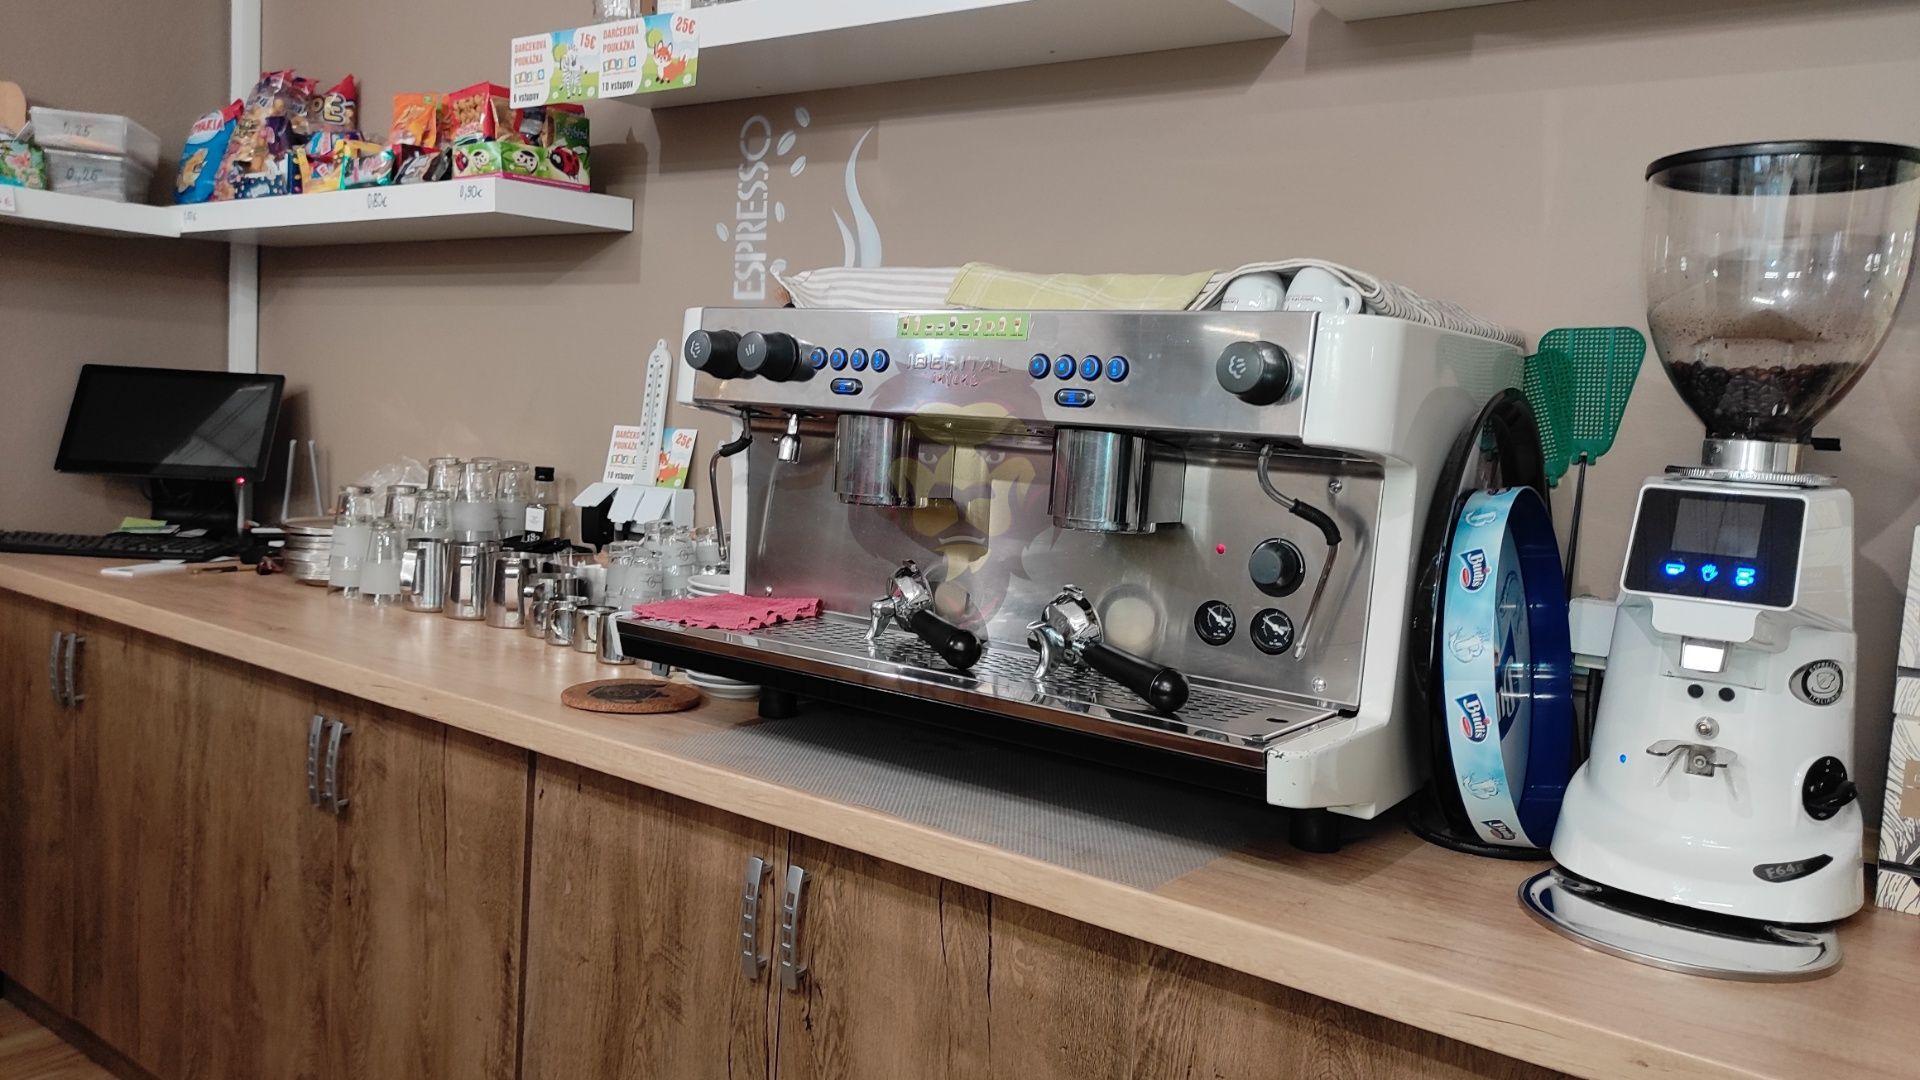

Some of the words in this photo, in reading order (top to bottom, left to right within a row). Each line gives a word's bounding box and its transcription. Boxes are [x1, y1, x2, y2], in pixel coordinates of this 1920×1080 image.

[675, 16, 696, 35] 25€
[580, 32, 597, 50] 15€
[602, 82, 609, 91] 10
[611, 80, 634, 91] vstupov
[519, 92, 539, 102] vstupov
[733, 115, 772, 300] ESPRESSO
[906, 353, 1010, 374] IBERITAL
[675, 432, 693, 449] 25€
[615, 472, 635, 481] vstupov
[1463, 698, 1487, 739] Budiš
